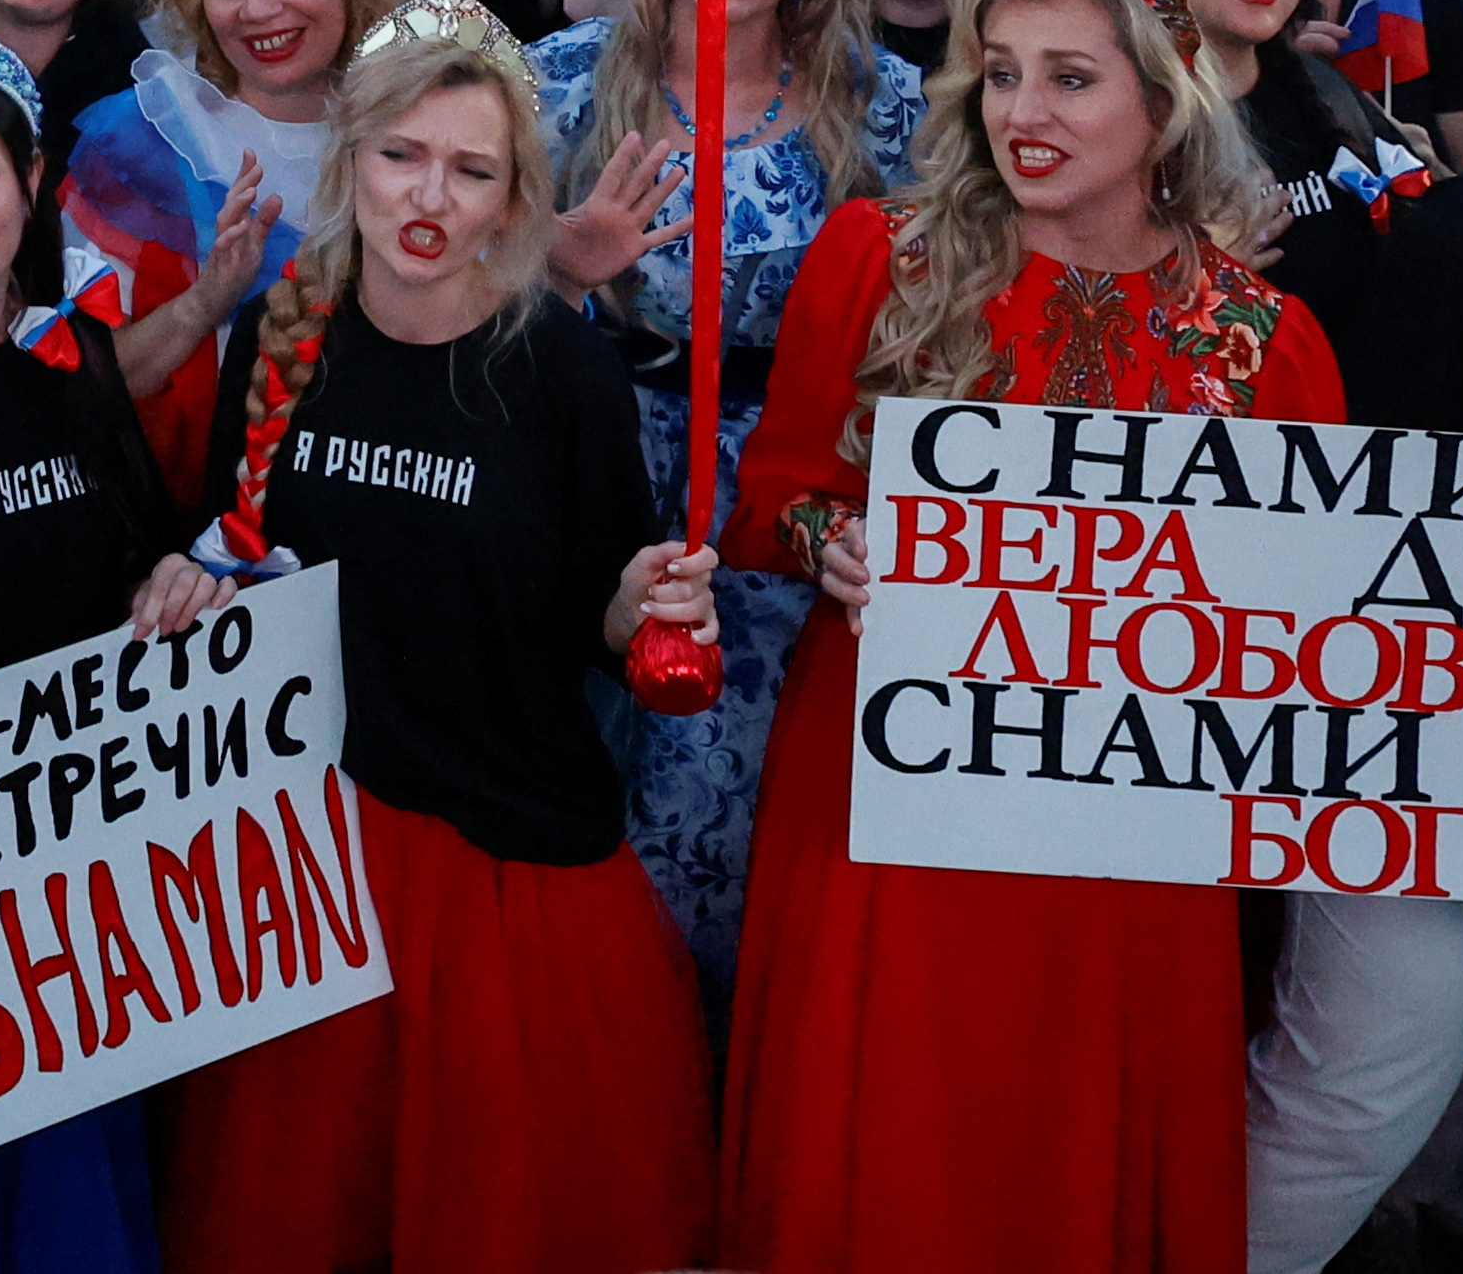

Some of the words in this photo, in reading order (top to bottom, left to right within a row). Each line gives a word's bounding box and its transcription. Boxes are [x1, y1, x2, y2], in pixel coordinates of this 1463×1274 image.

[293, 430, 314, 473] Я
[324, 435, 476, 506] РУССКИЙ
[911, 404, 1001, 494] С
[879, 494, 1221, 604] ВЕРА
[264, 674, 312, 757] С
